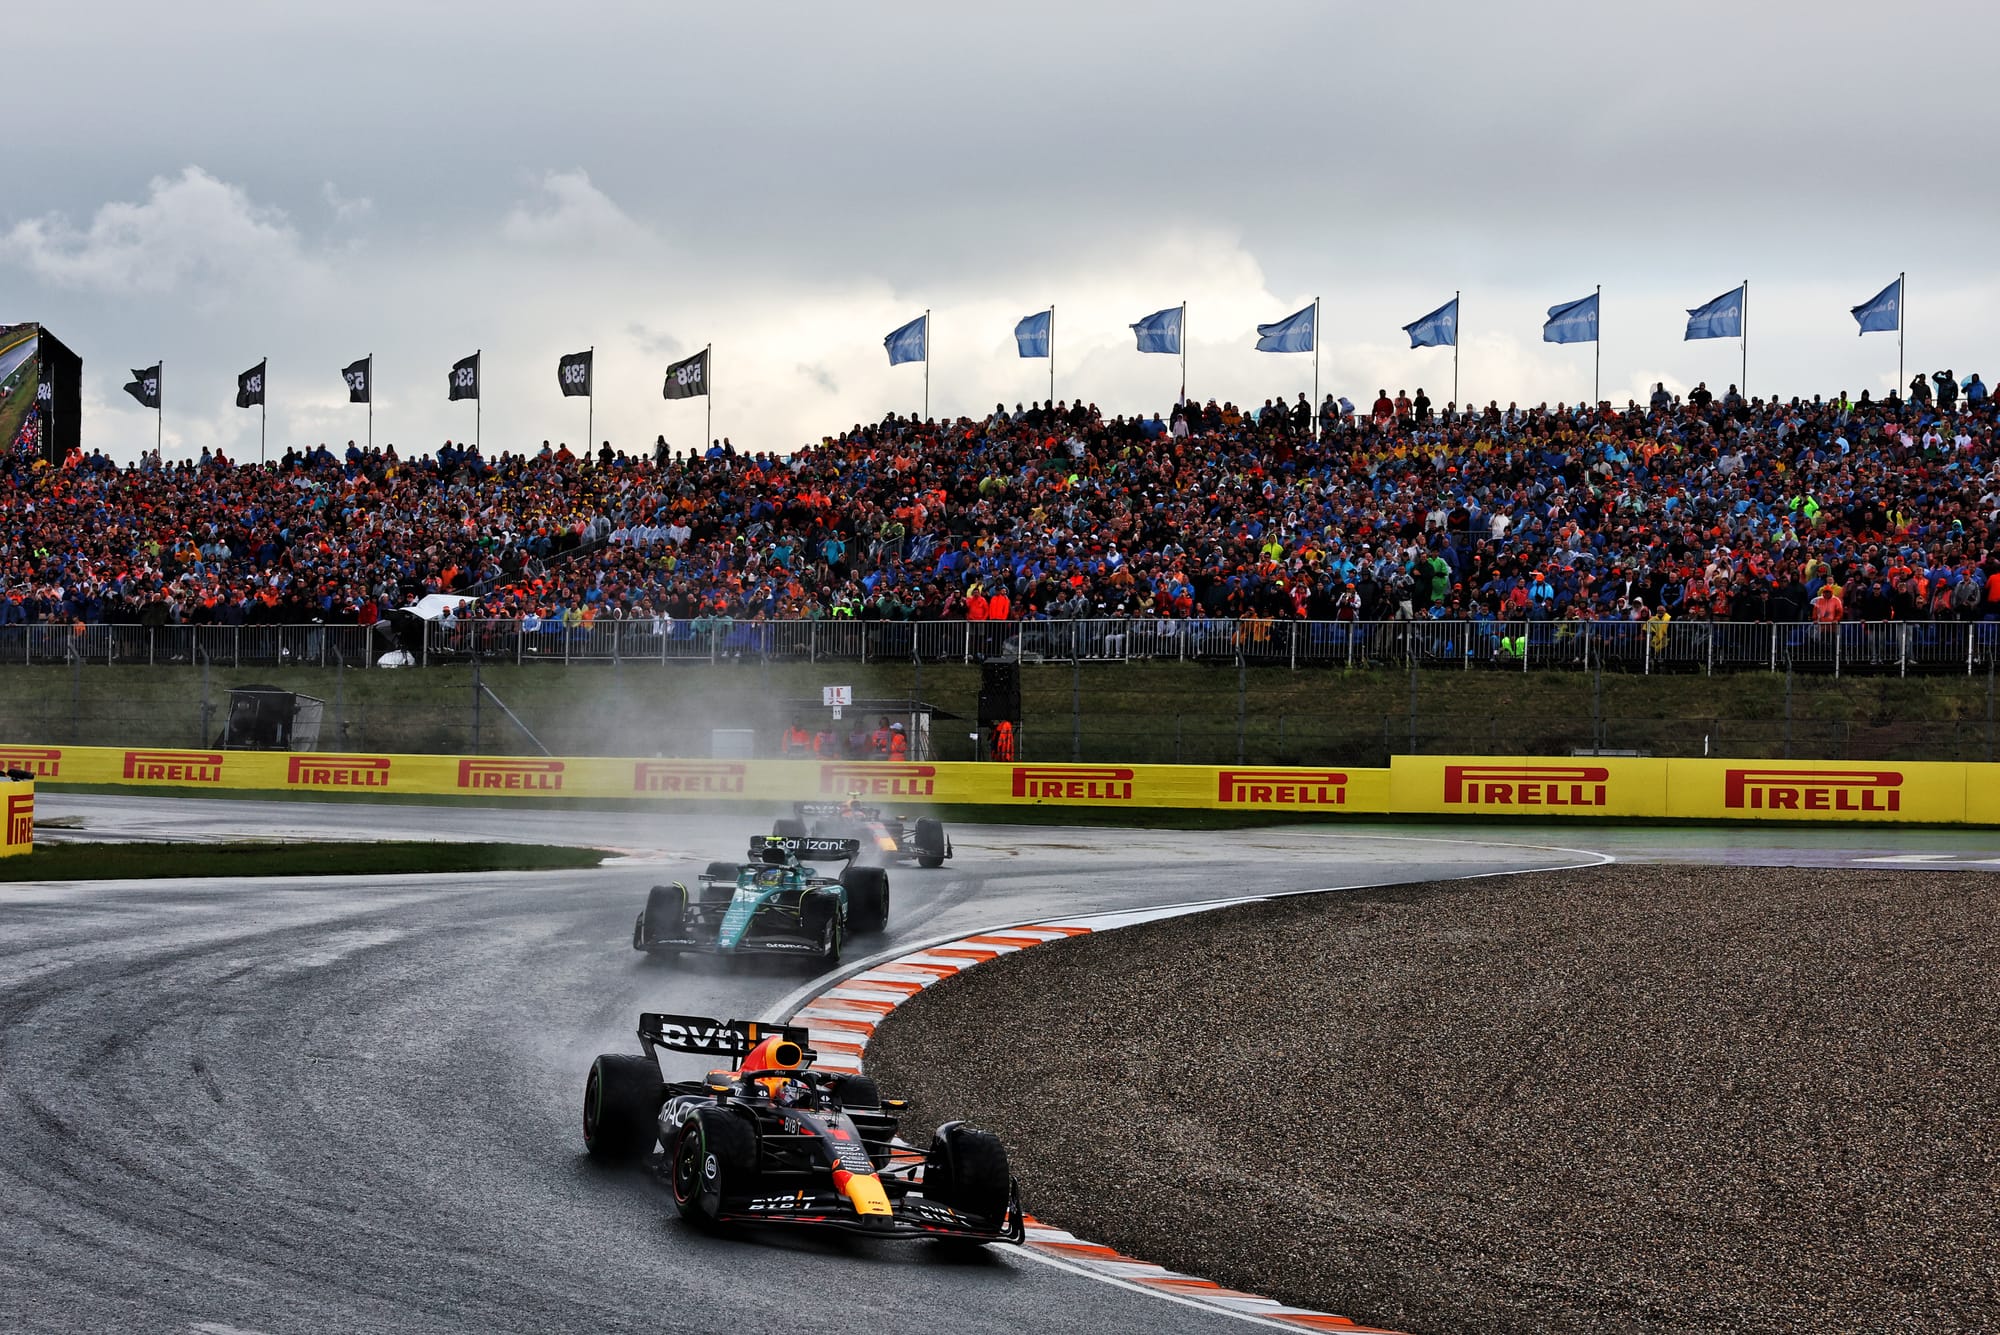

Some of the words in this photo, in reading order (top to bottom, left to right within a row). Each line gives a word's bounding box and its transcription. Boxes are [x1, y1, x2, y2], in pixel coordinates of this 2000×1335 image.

[0, 749, 61, 776] ELLI
[123, 752, 223, 782] PIRELLI
[288, 756, 391, 786] PIRELLI
[458, 760, 565, 790] PIRELLI
[634, 763, 746, 793] PIRELLI
[820, 765, 936, 796] PIRELLI
[1012, 768, 1134, 799] PIRELLI
[1219, 771, 1348, 804] PIRELLI
[1444, 766, 1609, 806] PIRELLI
[1725, 769, 1904, 812] PIRELLI
[7, 794, 34, 845] PIRE
